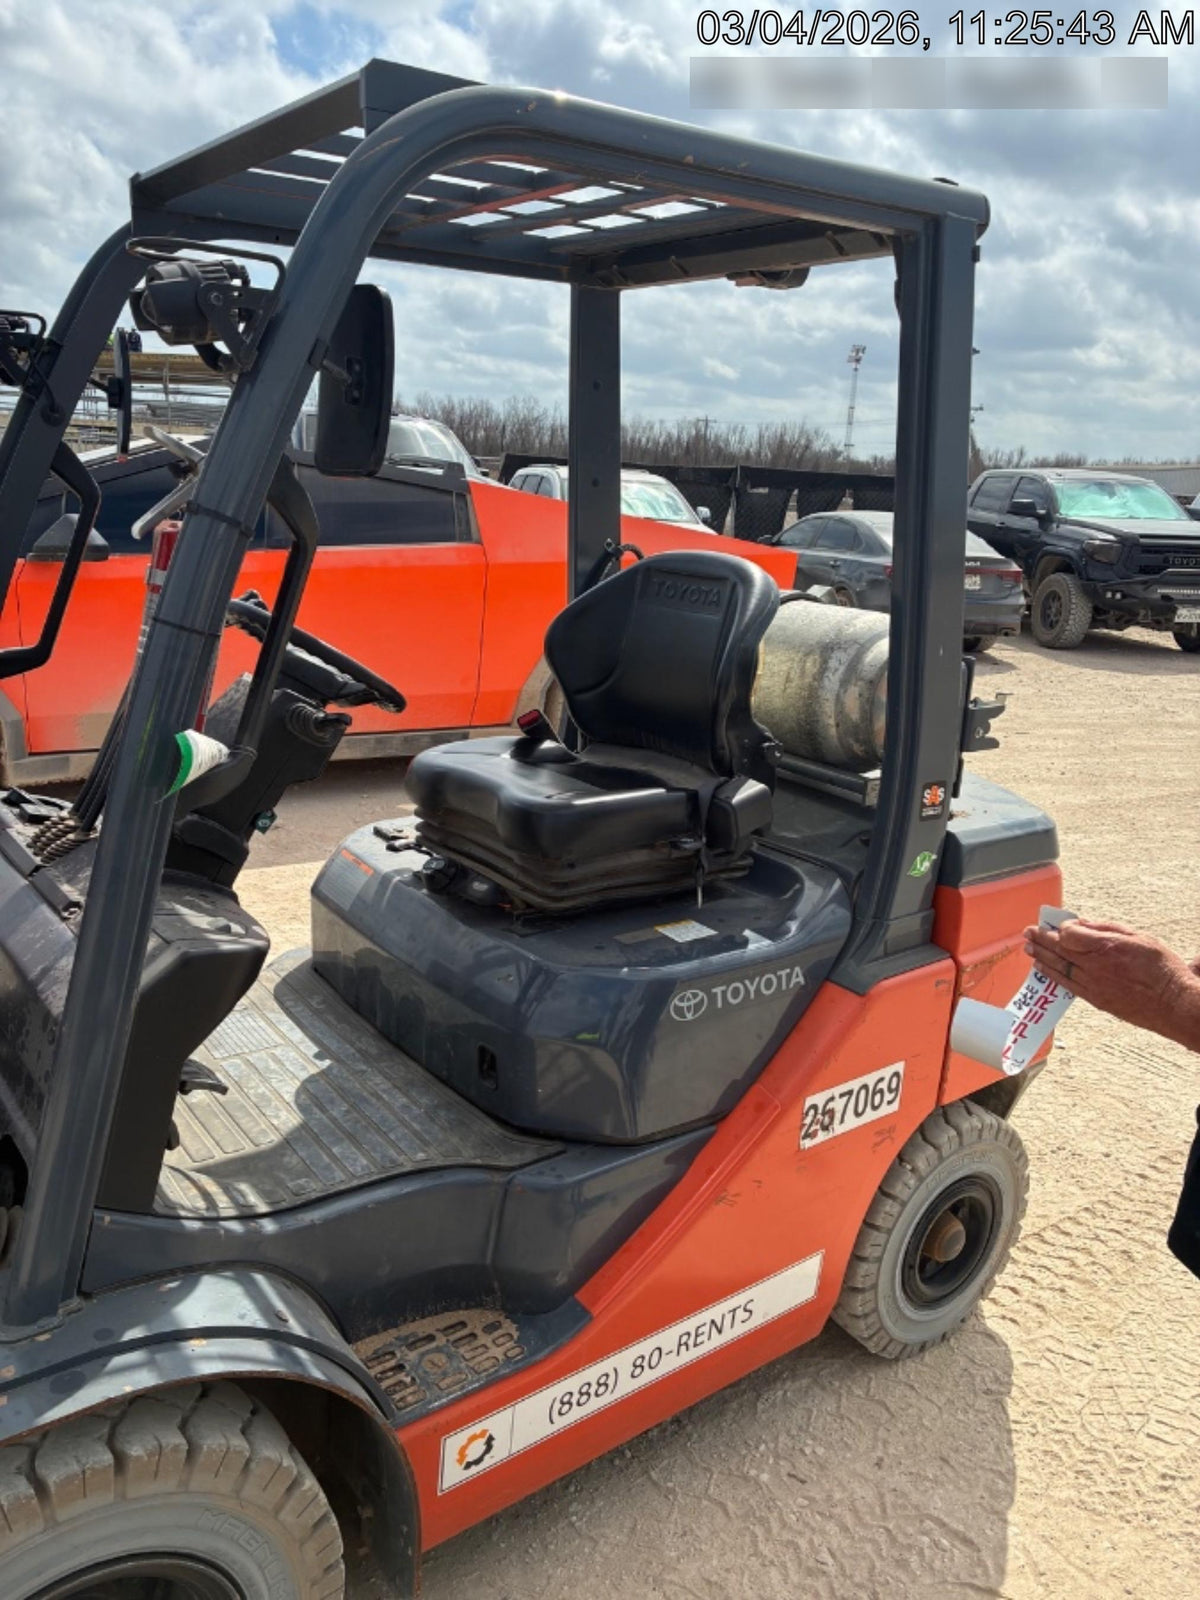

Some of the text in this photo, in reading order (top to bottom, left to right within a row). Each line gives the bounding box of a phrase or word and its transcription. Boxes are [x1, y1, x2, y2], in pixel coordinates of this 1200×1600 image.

[655, 578, 721, 607] TOYOTA
[711, 966, 806, 1008] TOYOTA
[801, 1070, 901, 1140] 267069
[547, 1298, 755, 1425] (888) 80-RENTS
